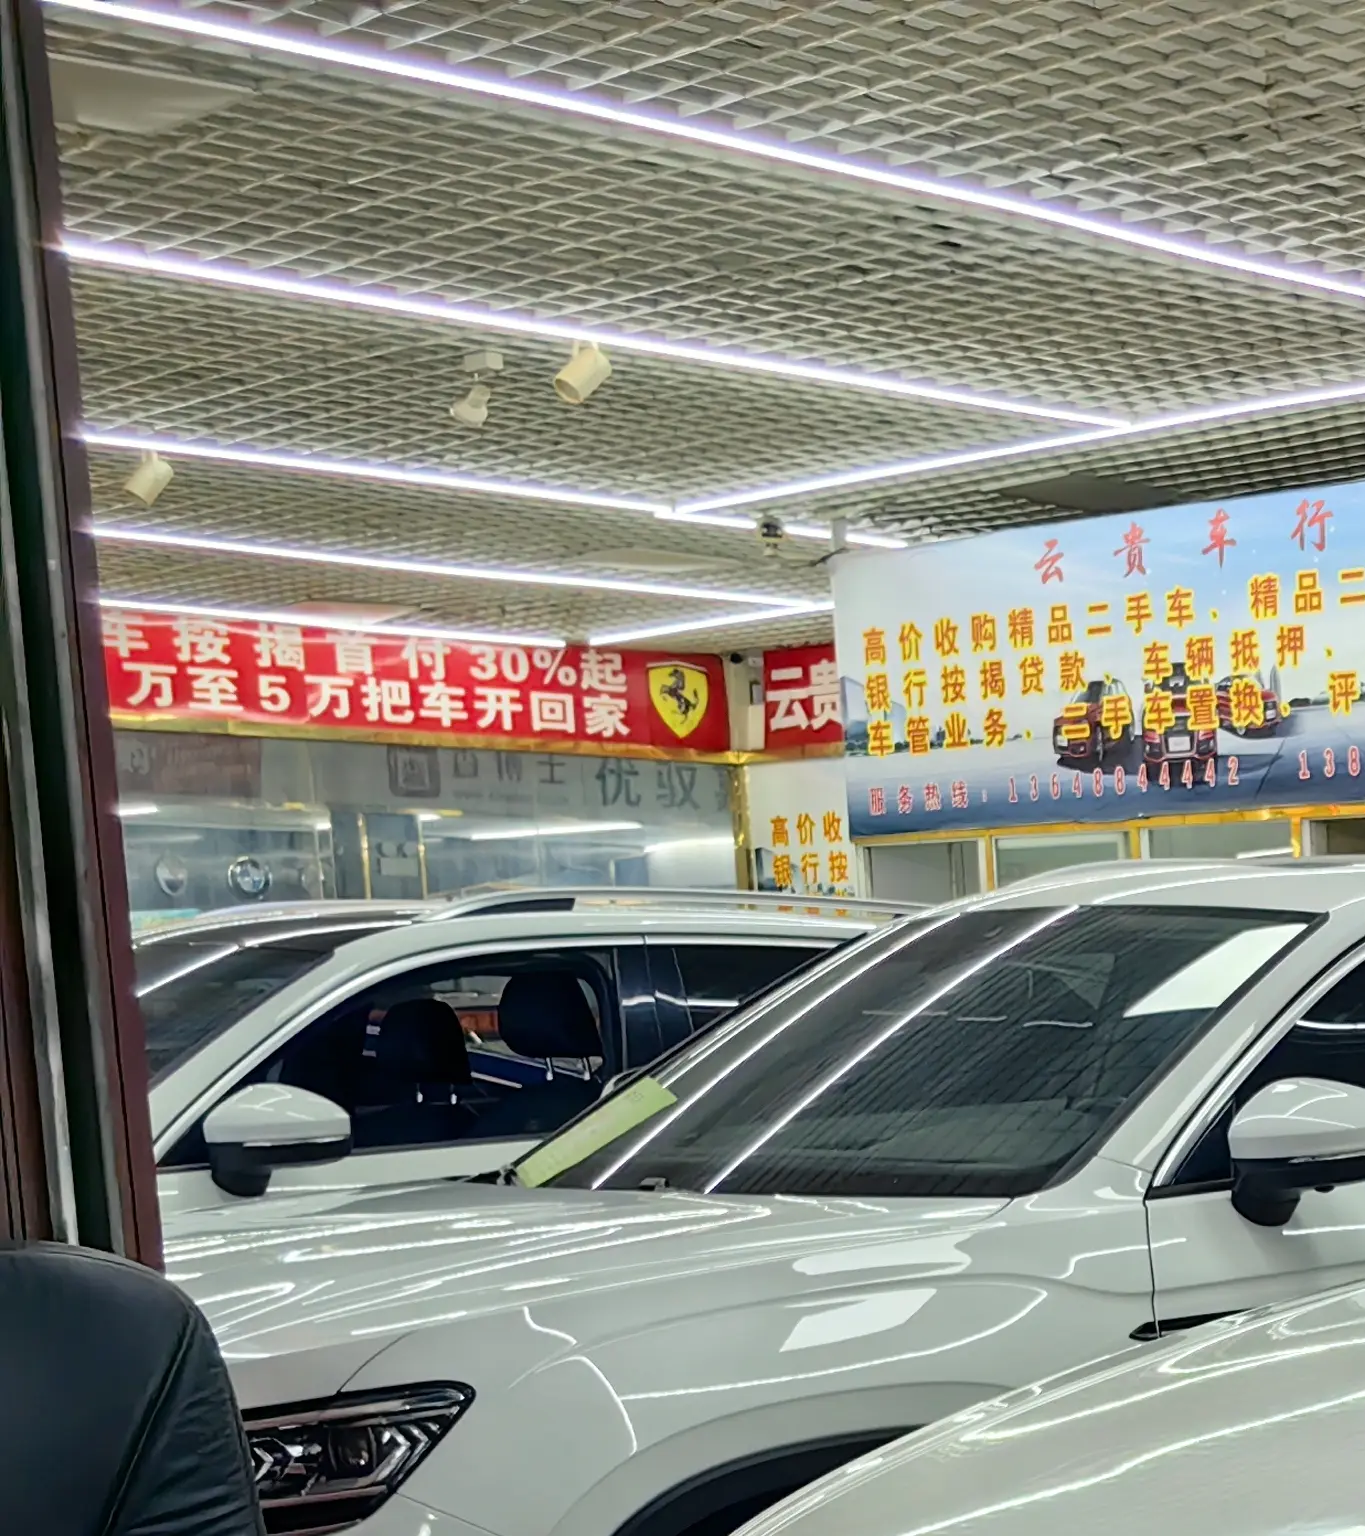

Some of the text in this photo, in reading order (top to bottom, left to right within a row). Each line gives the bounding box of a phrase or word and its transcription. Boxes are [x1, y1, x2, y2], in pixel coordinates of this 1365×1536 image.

[1034, 498, 1334, 585] 云贵车行
[122, 661, 631, 738] 万至5万把车开回家
[766, 657, 843, 733] 云贵
[769, 811, 843, 848] 高价收
[773, 851, 850, 889] 银行按
